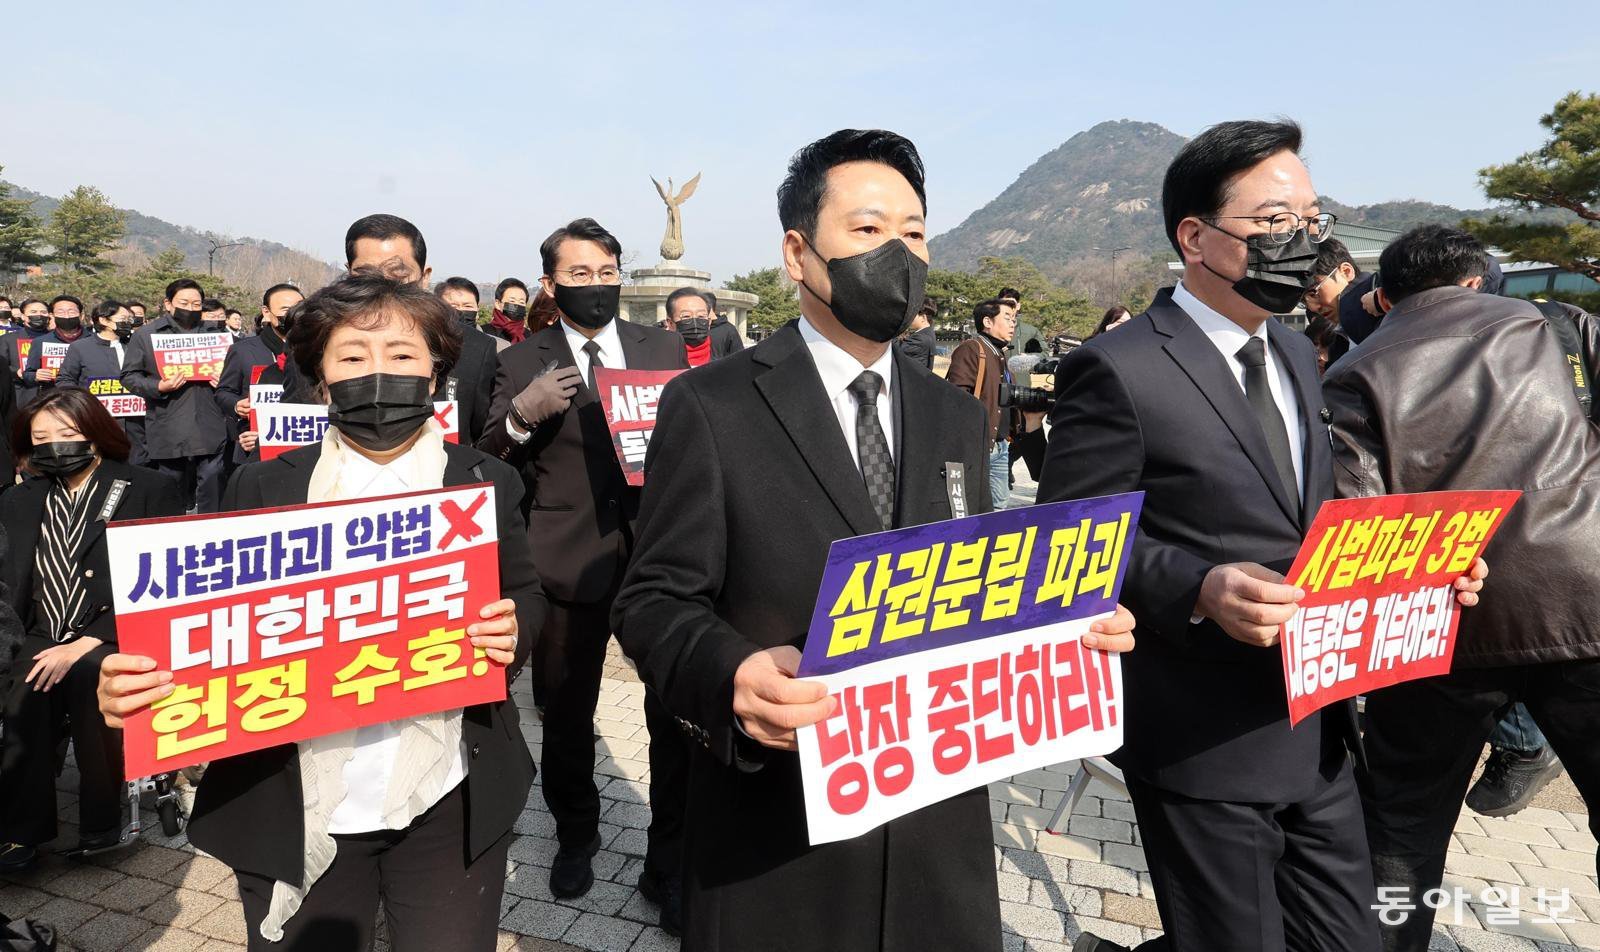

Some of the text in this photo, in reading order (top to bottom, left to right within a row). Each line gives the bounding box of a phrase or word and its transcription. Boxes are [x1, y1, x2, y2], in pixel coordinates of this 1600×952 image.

[89, 379, 131, 395] 삼권분
[1573, 364, 1586, 388] Nikon
[128, 504, 432, 603] 사법파괴 악법
[826, 512, 1131, 658] 삼권분립 파괴
[1294, 507, 1502, 593] 사법파괴 3법
[170, 560, 469, 671] 대한민국
[150, 659, 308, 760] 헌정
[814, 639, 1118, 816] 당장 중단하라!
